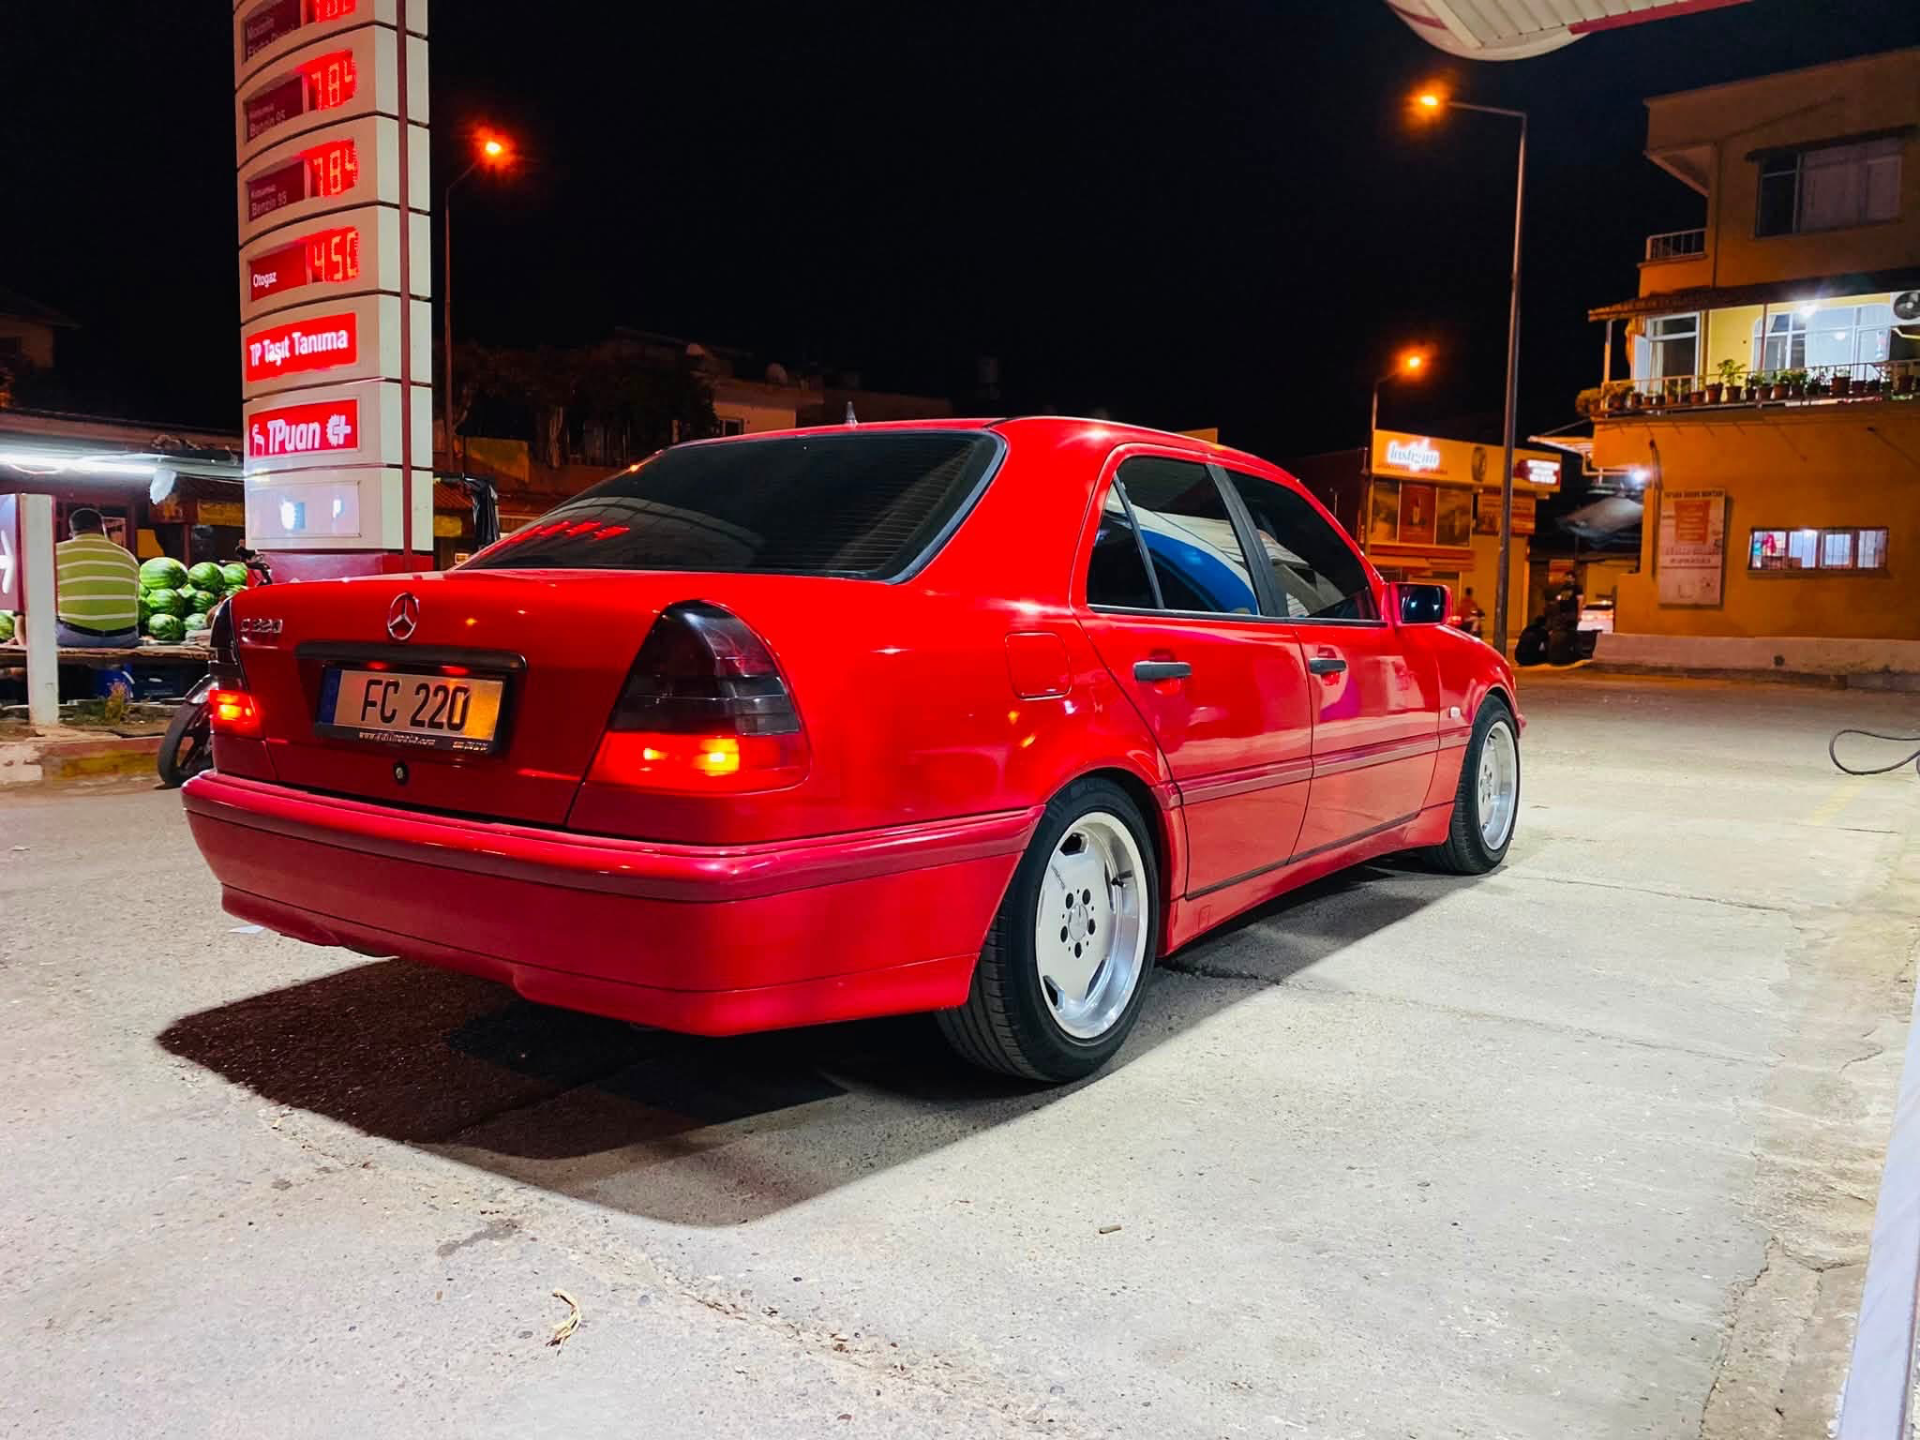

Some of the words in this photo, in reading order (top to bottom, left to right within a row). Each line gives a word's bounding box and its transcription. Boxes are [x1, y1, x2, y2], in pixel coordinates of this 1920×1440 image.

[253, 271, 277, 288] Otogaz
[250, 344, 262, 367] TP
[263, 336, 290, 366] Taşıt
[292, 329, 349, 356] Tanıma
[361, 679, 400, 724] FC
[409, 682, 470, 731] 220
